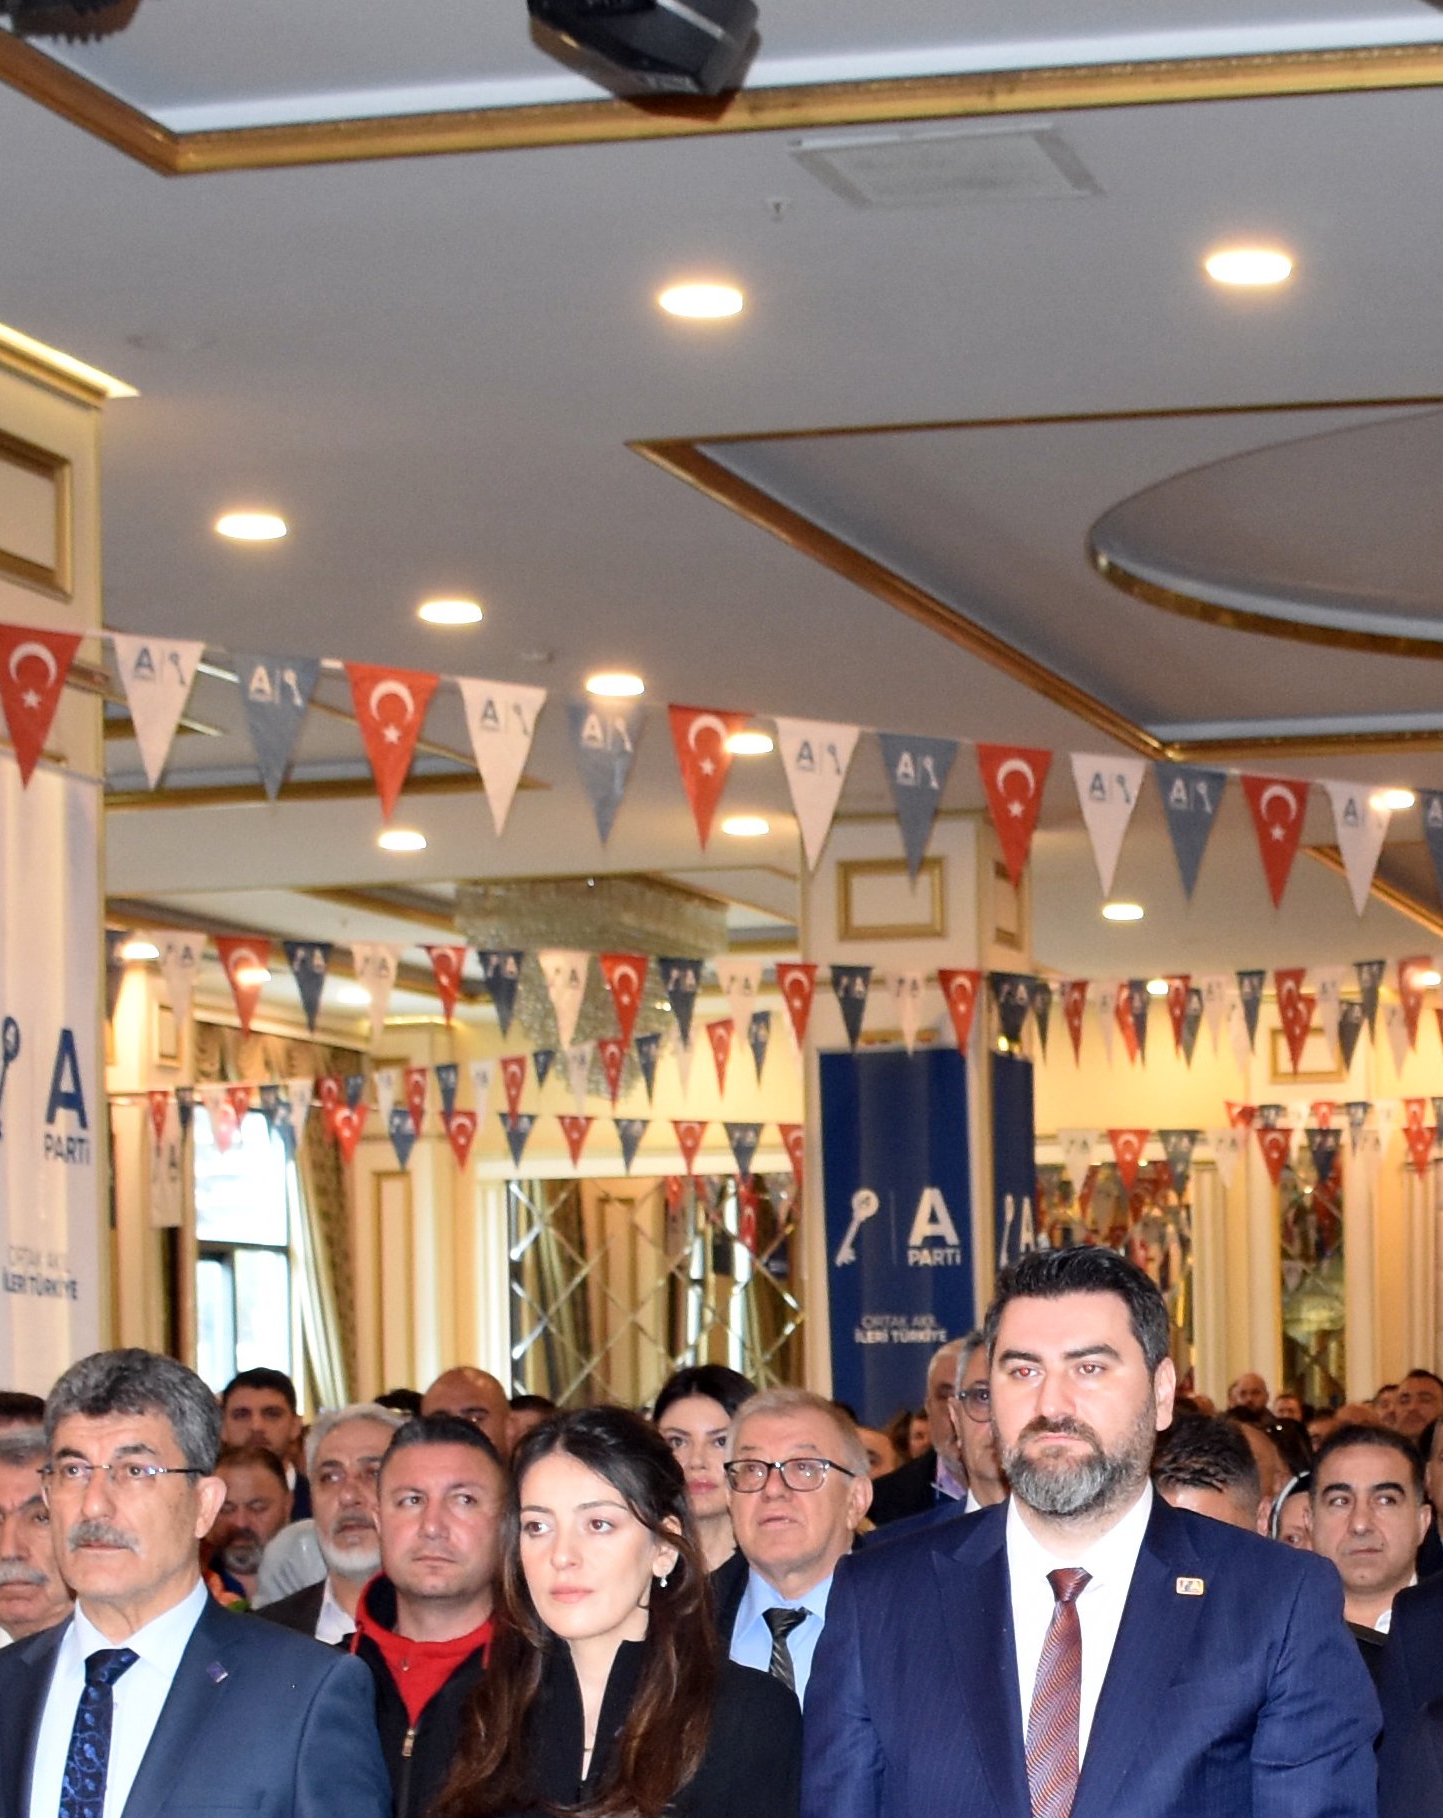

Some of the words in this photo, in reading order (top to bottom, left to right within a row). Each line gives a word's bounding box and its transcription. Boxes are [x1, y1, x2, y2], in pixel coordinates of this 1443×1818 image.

[134, 647, 155, 673] A
[250, 665, 272, 693] A
[480, 697, 499, 722] A
[581, 714, 604, 739] A
[796, 740, 814, 763] A
[896, 751, 914, 775] A
[1089, 772, 1105, 792] A
[1170, 777, 1187, 800] A
[1344, 797, 1356, 816] A
[1428, 798, 1443, 820] A
[46, 1028, 88, 1129] A
[909, 1186, 960, 1246] A
